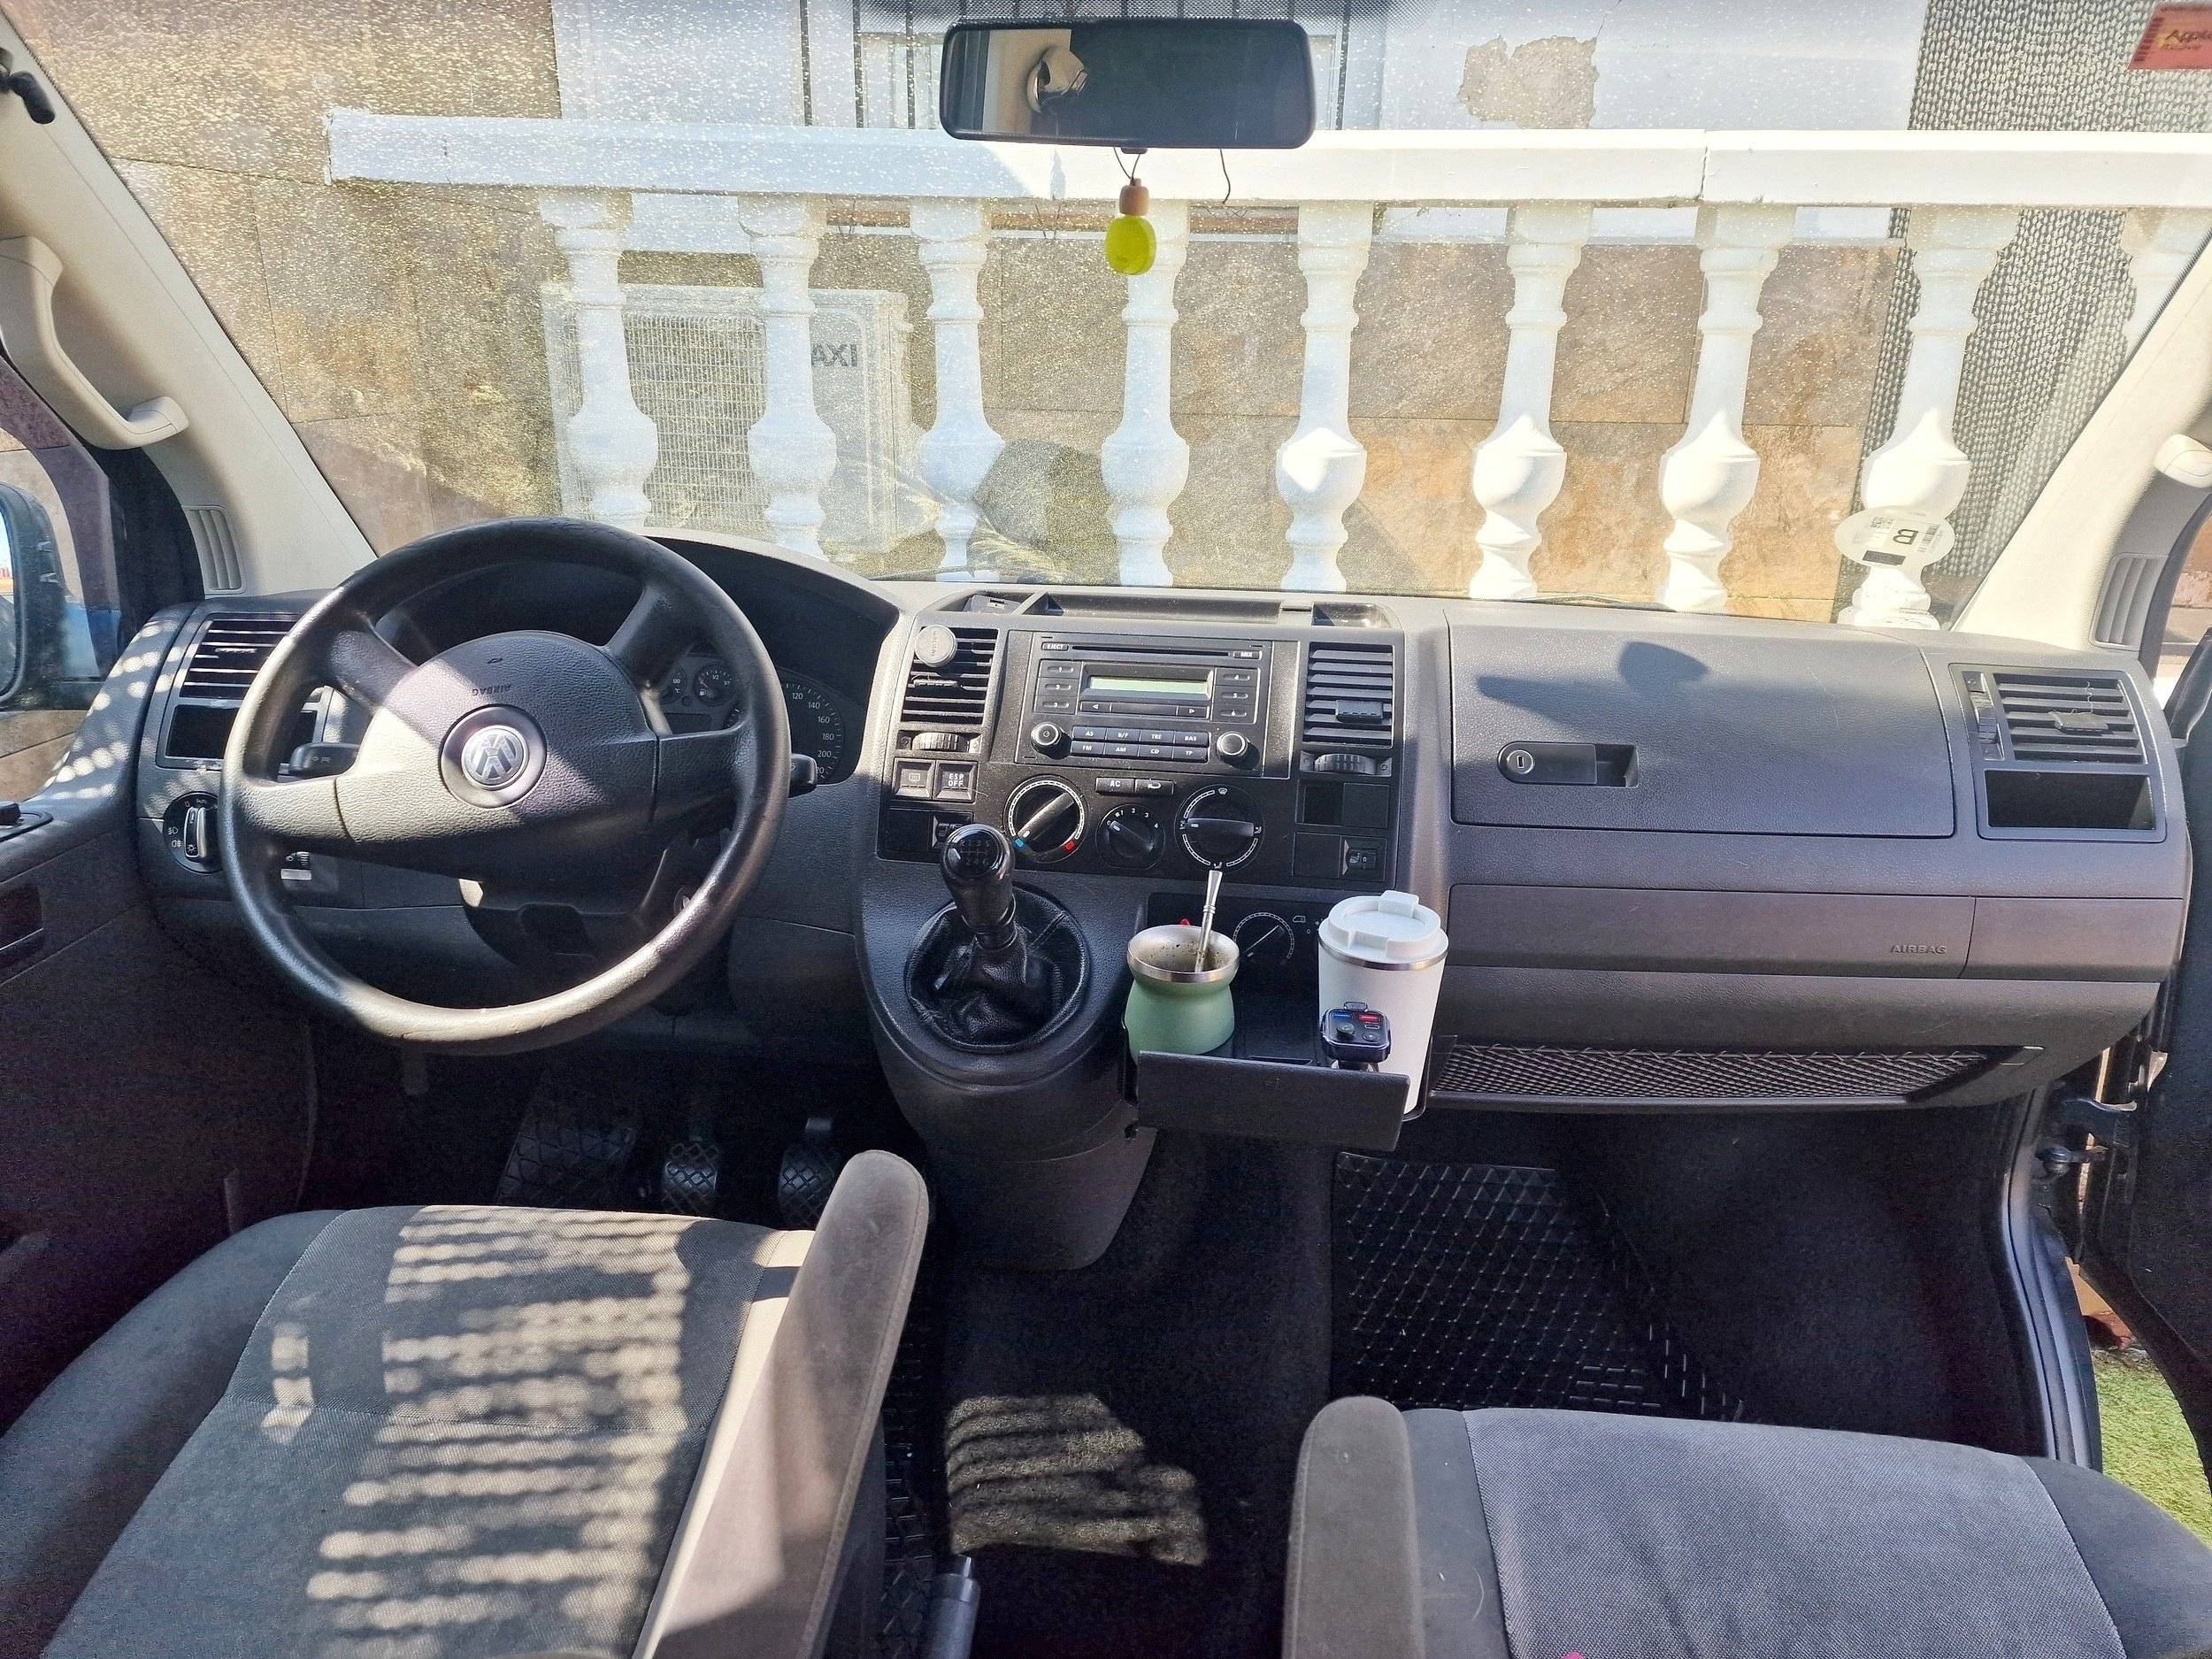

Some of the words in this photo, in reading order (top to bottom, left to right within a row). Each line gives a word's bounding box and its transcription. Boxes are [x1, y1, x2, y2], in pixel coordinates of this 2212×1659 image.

[810, 343, 857, 367] AXI
[792, 692, 803, 701] 120
[818, 749, 832, 758] 200
[1890, 943, 1947, 955] AIRBAG
